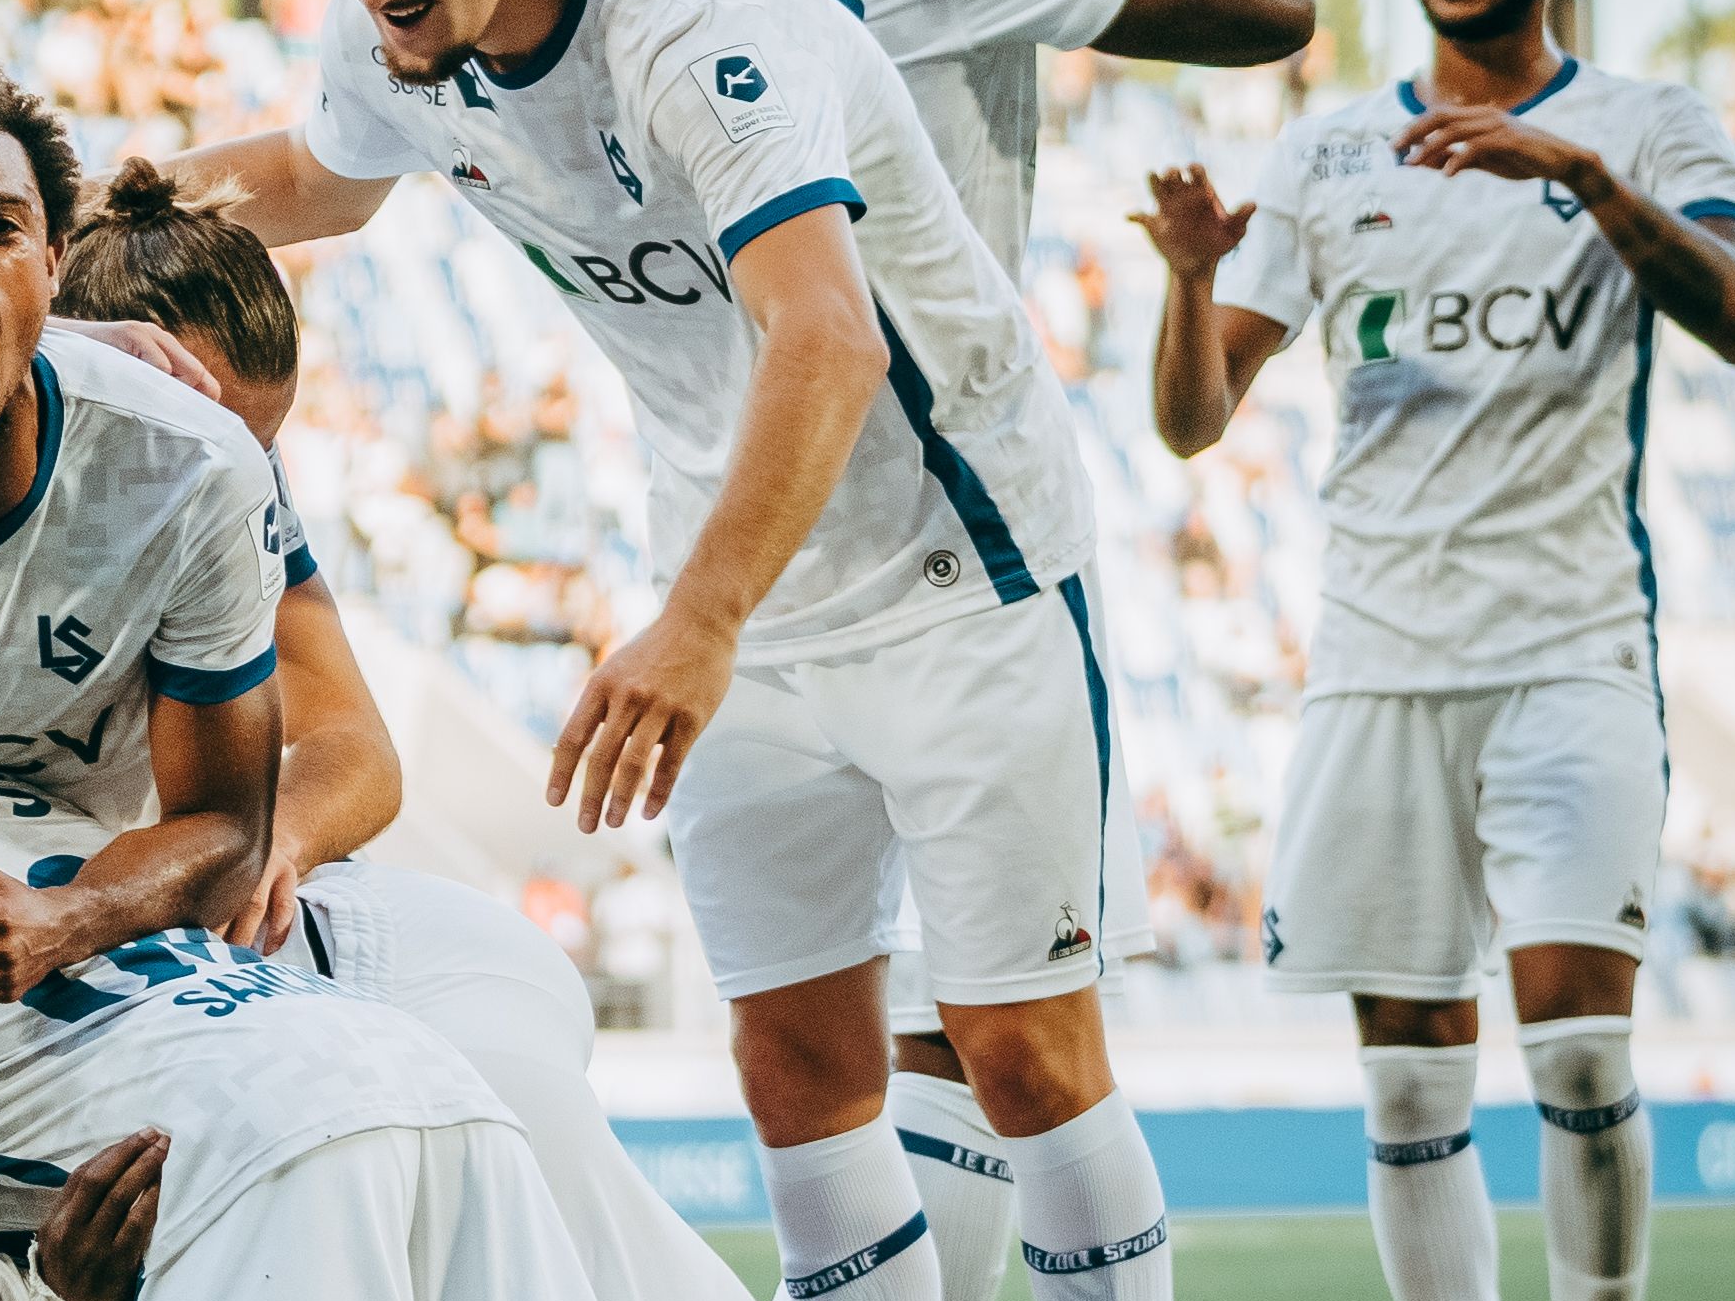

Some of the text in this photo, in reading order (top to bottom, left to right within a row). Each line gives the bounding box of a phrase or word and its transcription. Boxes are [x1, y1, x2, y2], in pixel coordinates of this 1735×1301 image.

[731, 118, 760, 134] Super
[570, 239, 734, 306] BCV
[1426, 285, 1593, 351] BCV
[1103, 1217, 1166, 1262] SPORT
[787, 1245, 880, 1298] SPORTIF
